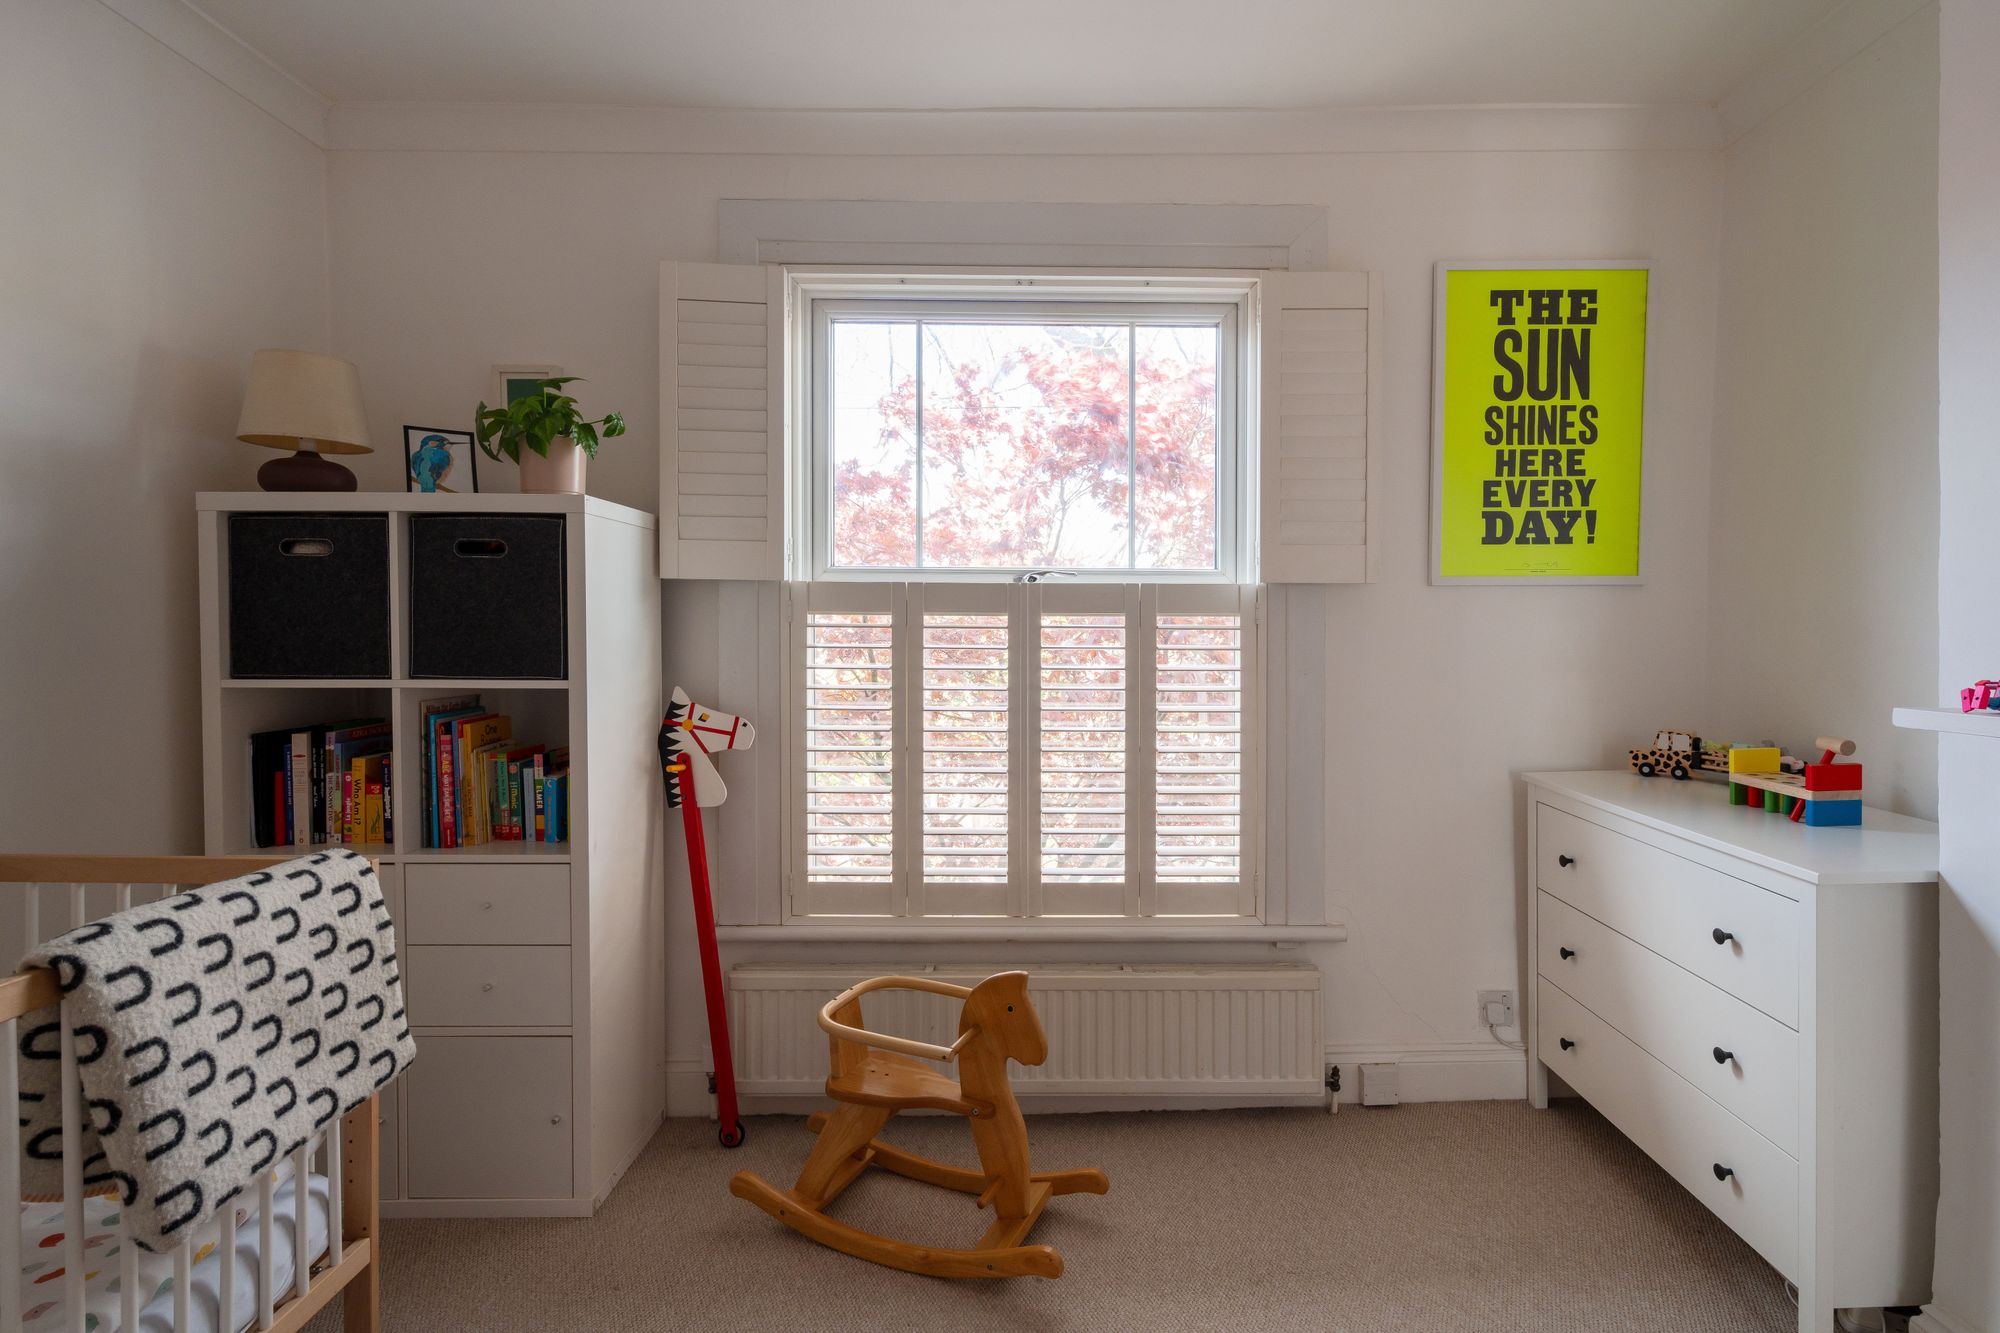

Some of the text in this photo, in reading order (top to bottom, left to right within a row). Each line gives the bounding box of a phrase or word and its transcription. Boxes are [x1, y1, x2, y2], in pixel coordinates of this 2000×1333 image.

[1490, 289, 1598, 325] THE
[1493, 328, 1591, 401] SUN
[1484, 405, 1599, 446] SHINES
[1495, 449, 1586, 477] HERE
[1482, 479, 1597, 508] EVERY
[1481, 510, 1597, 545] DAY!
[354, 779, 362, 799] Who
[354, 801, 360, 815] Am
